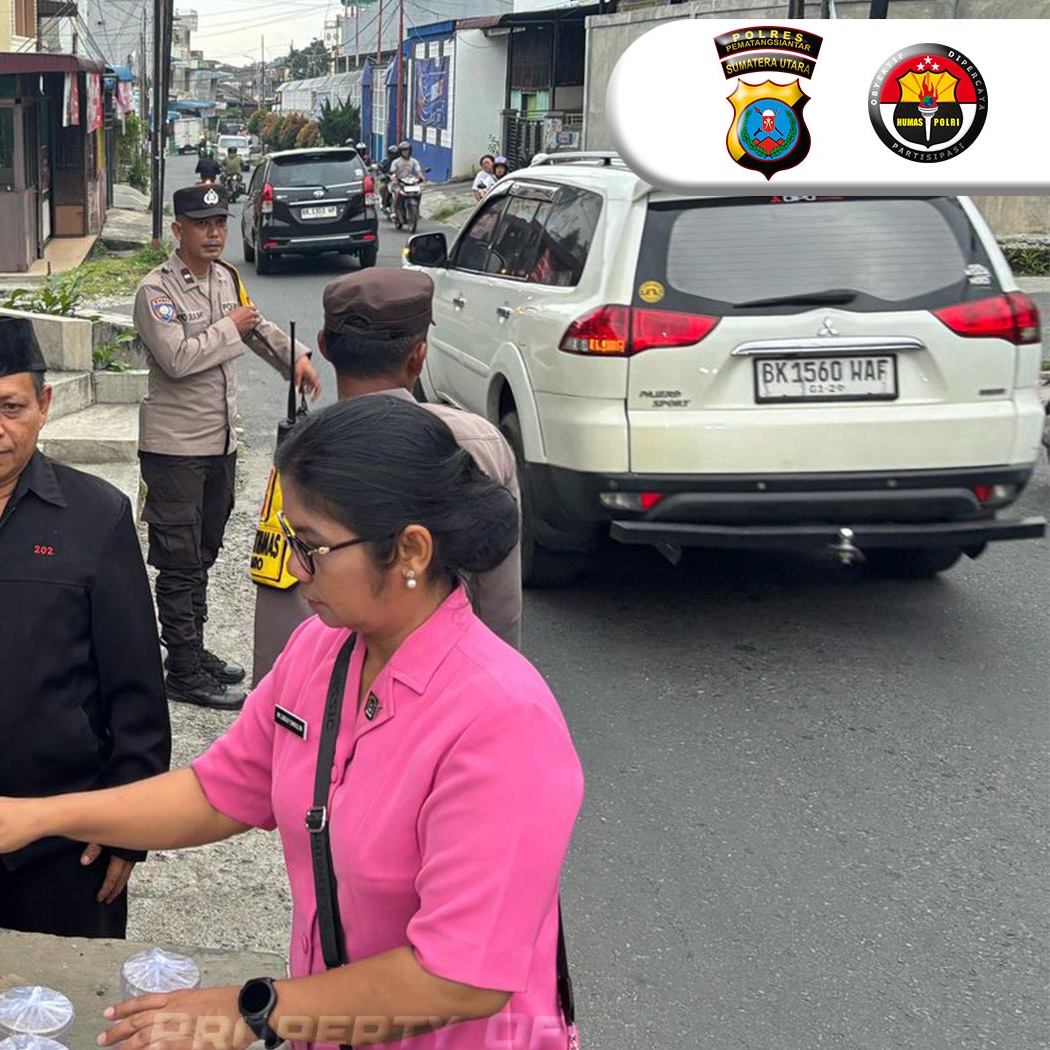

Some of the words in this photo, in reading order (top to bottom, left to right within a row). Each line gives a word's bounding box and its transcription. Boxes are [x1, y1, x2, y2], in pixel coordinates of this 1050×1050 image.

[762, 363, 787, 383] BK
[792, 361, 842, 383] 1560
[851, 360, 888, 381] WAF
[34, 545, 53, 556] 202
